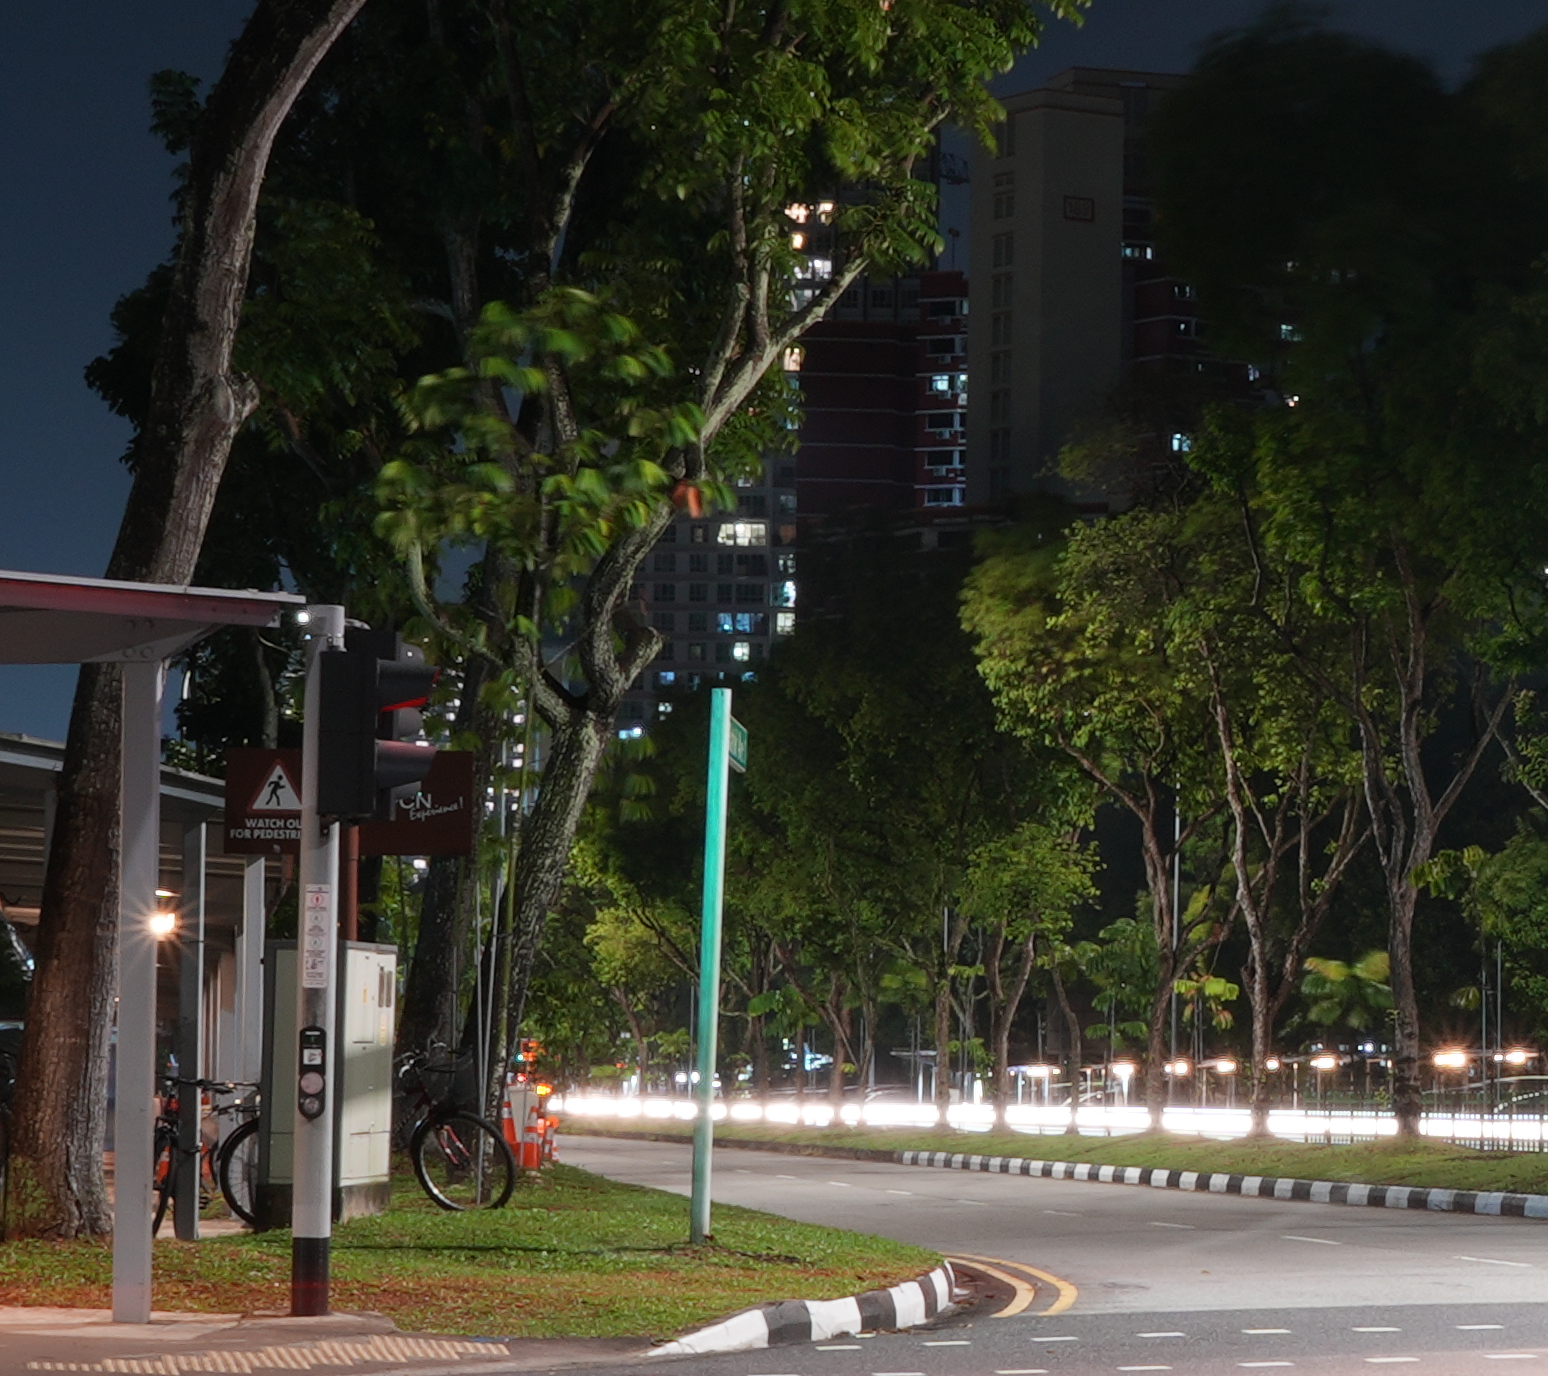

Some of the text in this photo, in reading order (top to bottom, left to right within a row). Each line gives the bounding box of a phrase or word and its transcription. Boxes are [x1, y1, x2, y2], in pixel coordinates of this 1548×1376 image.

[409, 796, 464, 822] Experience!
[245, 818, 302, 829] WATCH OU
[229, 829, 301, 840] FOR PEDESTRI
